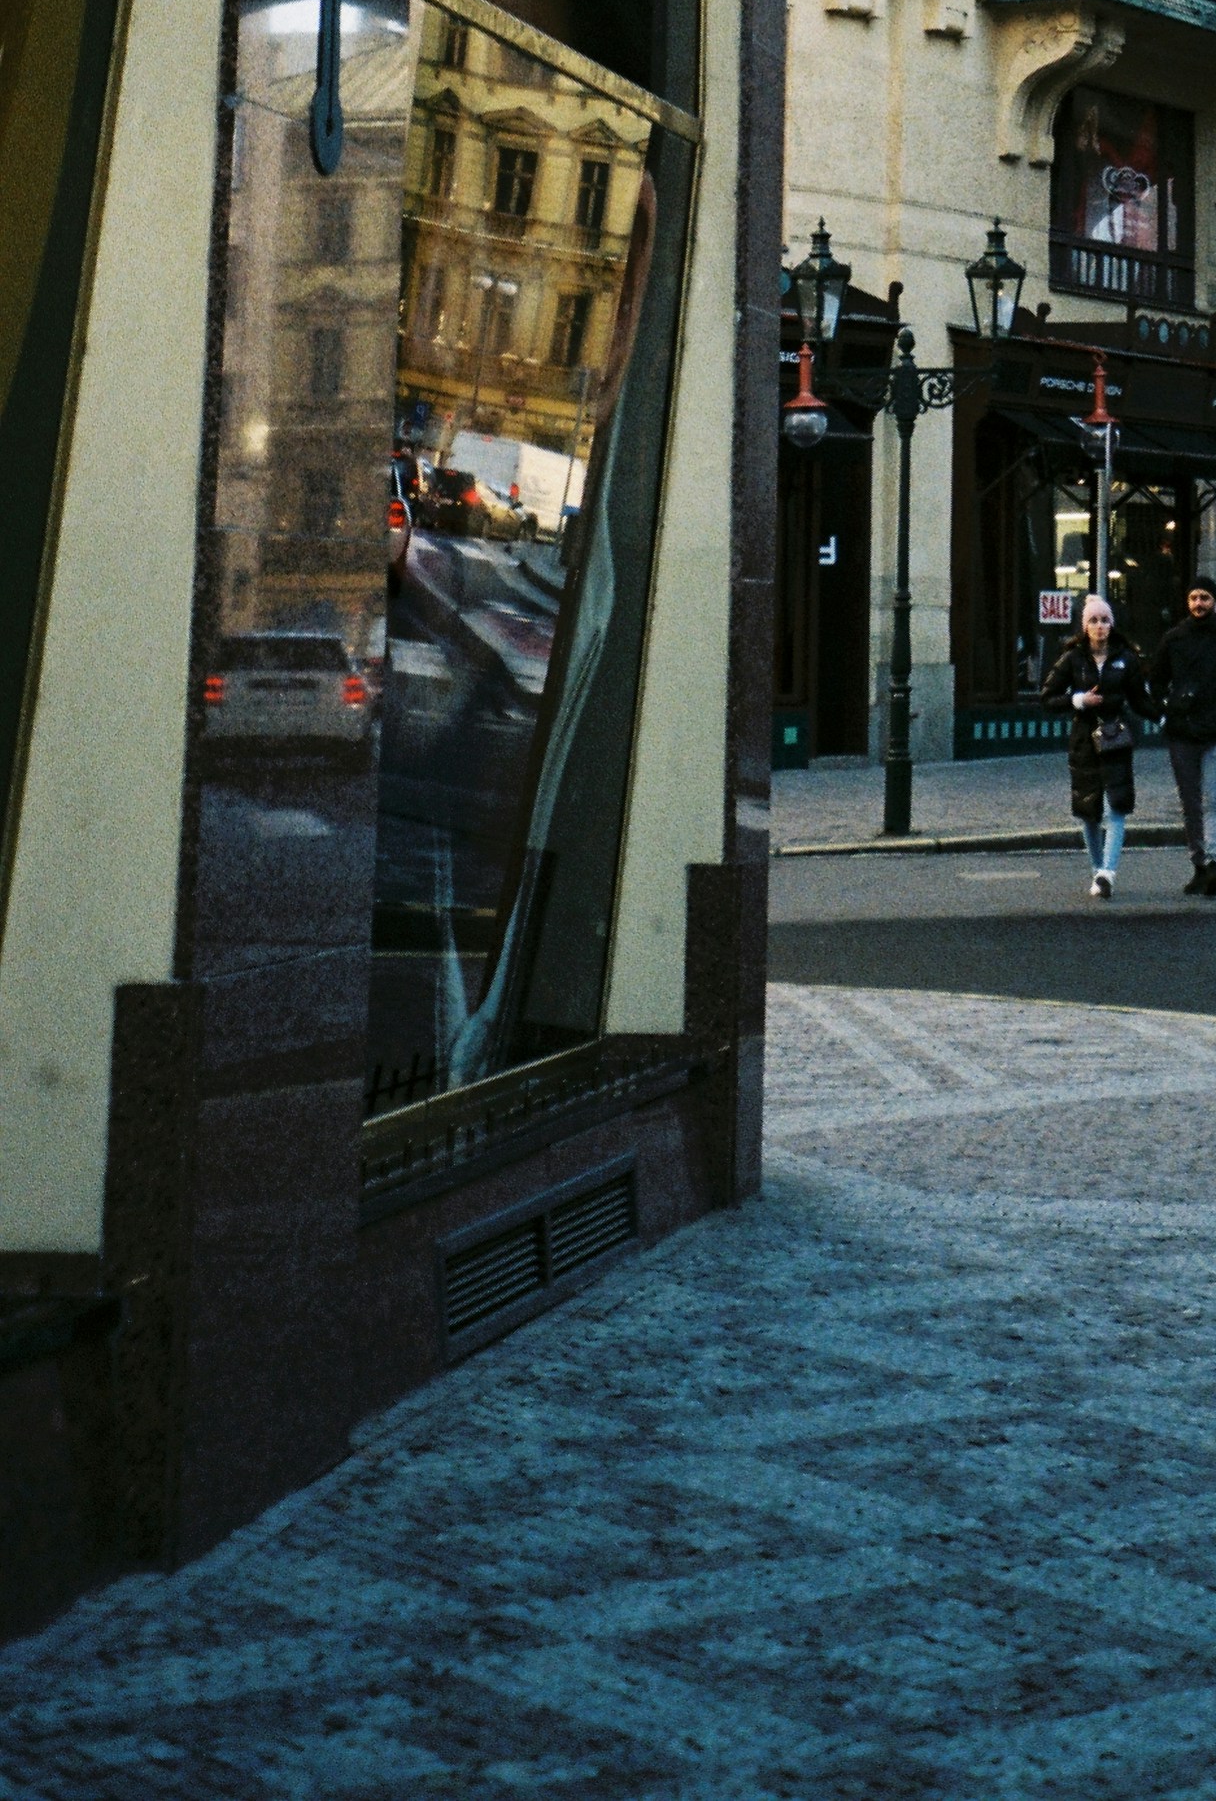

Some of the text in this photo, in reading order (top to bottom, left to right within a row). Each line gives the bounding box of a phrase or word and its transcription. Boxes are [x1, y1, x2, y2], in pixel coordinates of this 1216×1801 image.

[1040, 377, 1123, 396] PORSCHE DIGN
[1041, 594, 1070, 620] SALE
